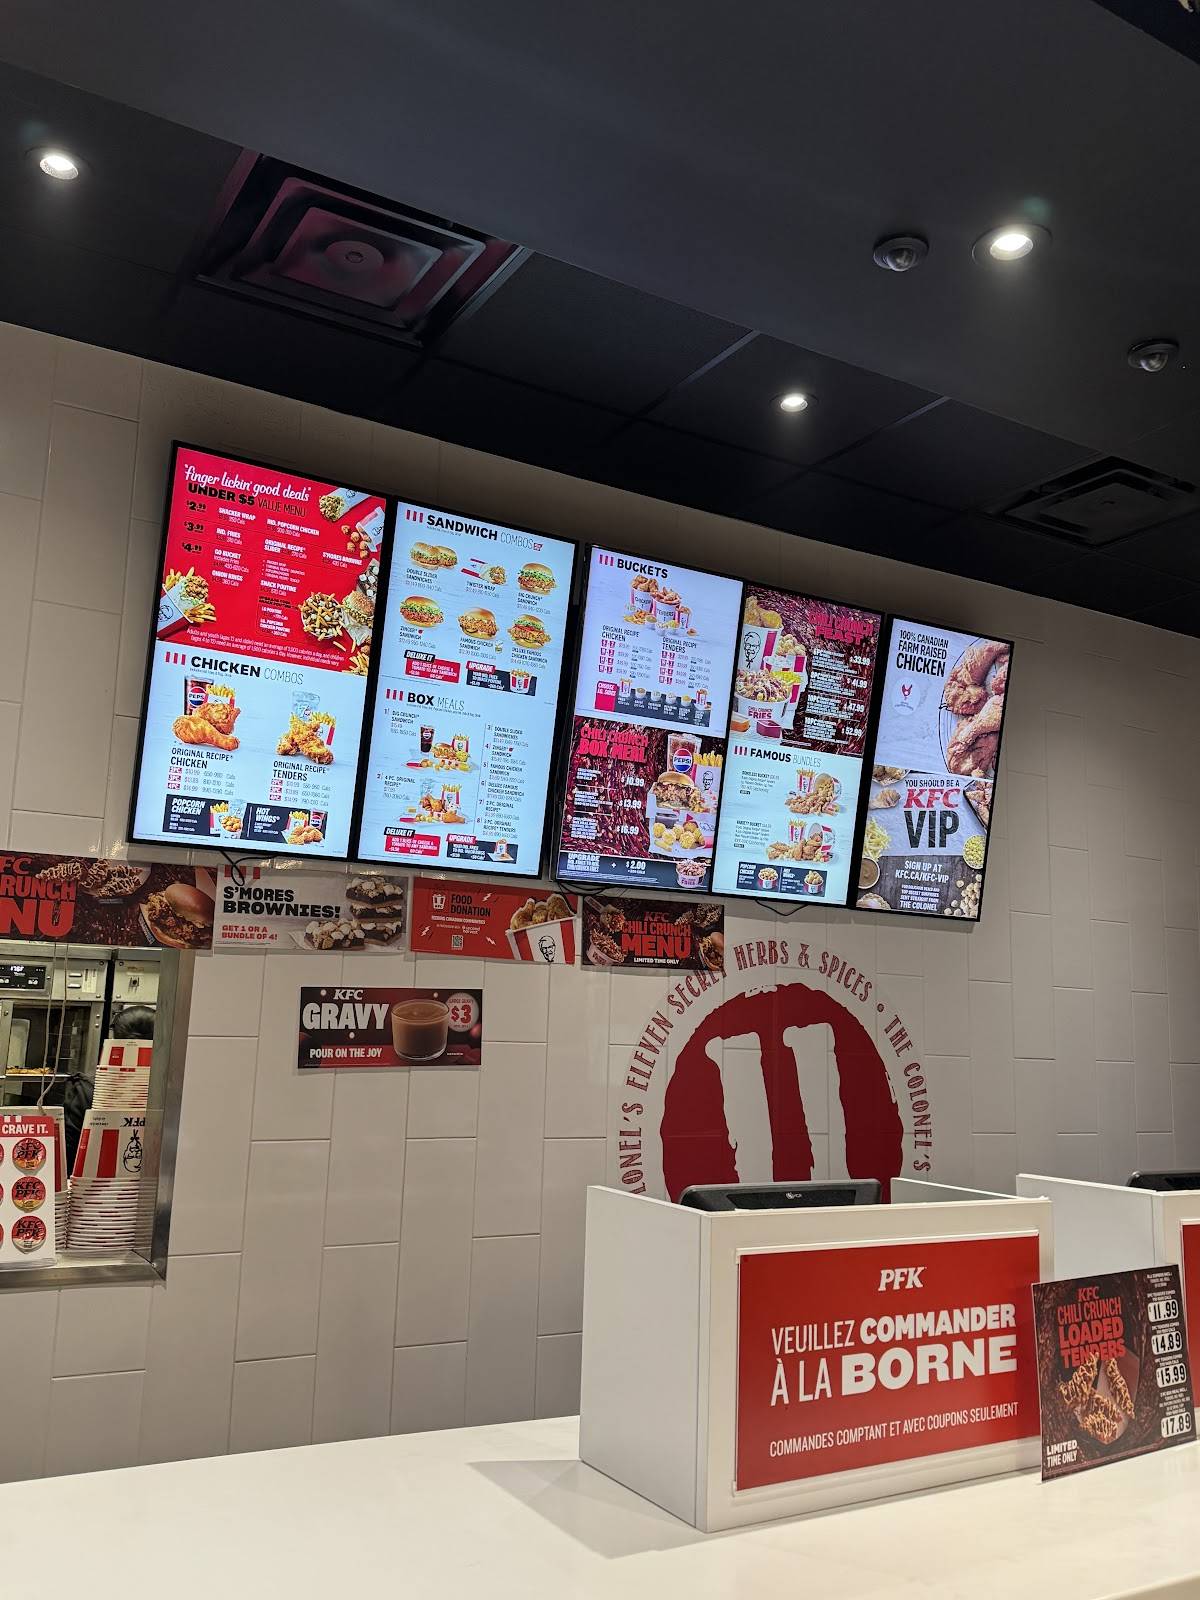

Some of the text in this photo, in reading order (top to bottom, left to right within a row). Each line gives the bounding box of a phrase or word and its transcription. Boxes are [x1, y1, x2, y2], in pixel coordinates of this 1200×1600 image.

[252, 482, 281, 497] good
[188, 483, 306, 517] UNDER $5 VALUE MENU
[241, 512, 256, 521] WRAP
[277, 520, 300, 532] POPCORN
[299, 525, 320, 536] CHICKEN
[426, 514, 534, 550] SANDWICH COMBOS
[227, 572, 243, 582] RINGS
[616, 558, 669, 579] BUCKETS
[260, 579, 276, 589] SNACK
[602, 625, 623, 634] ORIGINAL
[835, 616, 873, 636] CRUNCH
[601, 631, 626, 642] CHICKEN
[662, 636, 681, 646] ORIGINAL
[814, 625, 863, 646] FEAST
[899, 629, 949, 649] 100% CANADIAN
[406, 651, 434, 662] DELUXE IT
[662, 642, 686, 654] TENDERS
[898, 639, 948, 660] FARM RAISED
[191, 656, 304, 685] CHICKEN COMBOS
[468, 662, 494, 673] UPGRADE
[896, 652, 947, 678] CHICKEN
[407, 692, 465, 712] BOX MEALS
[748, 711, 772, 720] FRIES
[580, 726, 649, 748] CHILI CRUNCH
[171, 747, 205, 759] ORIGINAL
[578, 738, 647, 763] BOX MEAL
[750, 748, 822, 768] FAMOUS BUNDLES
[170, 757, 208, 769] CHICKEN
[273, 761, 304, 771] ORIGINAL
[673, 757, 692, 765] PEPSI
[273, 769, 308, 782] TENDERS
[904, 779, 961, 788] YOU SHOULD BE A
[172, 797, 206, 809] POPCORN
[903, 788, 961, 809] KFC
[171, 805, 202, 816] CHICKEN
[255, 807, 271, 816] HOT
[386, 828, 406, 836] DELUXE
[904, 810, 960, 849] VIP
[448, 835, 474, 845] UPGRADE
[0, 855, 32, 875] FC
[568, 852, 600, 861] UPGRADE
[904, 860, 943, 873] SIGN UP AT
[895, 869, 950, 884] KFC.CA/KFC-VIP
[0, 874, 77, 900] RUNCH
[223, 886, 295, 903] S'MORES
[451, 894, 473, 905] FOOD
[900, 900, 938, 911] THE COLONEL
[0, 897, 76, 937] NU
[223, 900, 341, 919] BROWNIES!
[450, 904, 491, 917] DONATION
[643, 911, 670, 923] KFC
[221, 931, 255, 940] BUNDLE
[222, 924, 240, 932] GET
[622, 920, 692, 938] CHILI CRUNCH
[621, 933, 692, 959] MENU
[633, 957, 655, 965] LIMITED
[733, 940, 789, 971] HERBS
[797, 942, 811, 969] &
[818, 951, 873, 1003] SPICES
[333, 989, 364, 1001] KFC
[302, 1003, 390, 1031] GRAVY
[451, 1004, 472, 1024] $3
[883, 1015, 913, 1058] THE
[309, 1047, 382, 1059] POUR ON THE JOY
[626, 1010, 674, 1092] ELEVEN
[903, 1062, 933, 1173] COLONEL'S
[2, 1124, 49, 1135] CRAVE IT.
[619, 1101, 647, 1194] LONEL'S
[16, 1181, 40, 1190] KFC
[16, 1189, 40, 1198] PFK
[16, 1220, 39, 1229] KFC
[877, 1266, 927, 1292] PFK
[1078, 1286, 1100, 1303] KFC
[1057, 1296, 1122, 1326] CHILI CRUNCH
[771, 1303, 1016, 1356] VEUILLEZ COMMANDER
[1058, 1316, 1124, 1349] LOADED
[1060, 1338, 1127, 1369] TENDERS
[770, 1334, 1018, 1407] À LA BORNE
[770, 1401, 1019, 1458] COMMANDES COMPTANT ET AVEC COUPONS SEULEMENT
[1046, 1439, 1078, 1456] LIMITED
[1046, 1449, 1078, 1468] TIME ONLY
